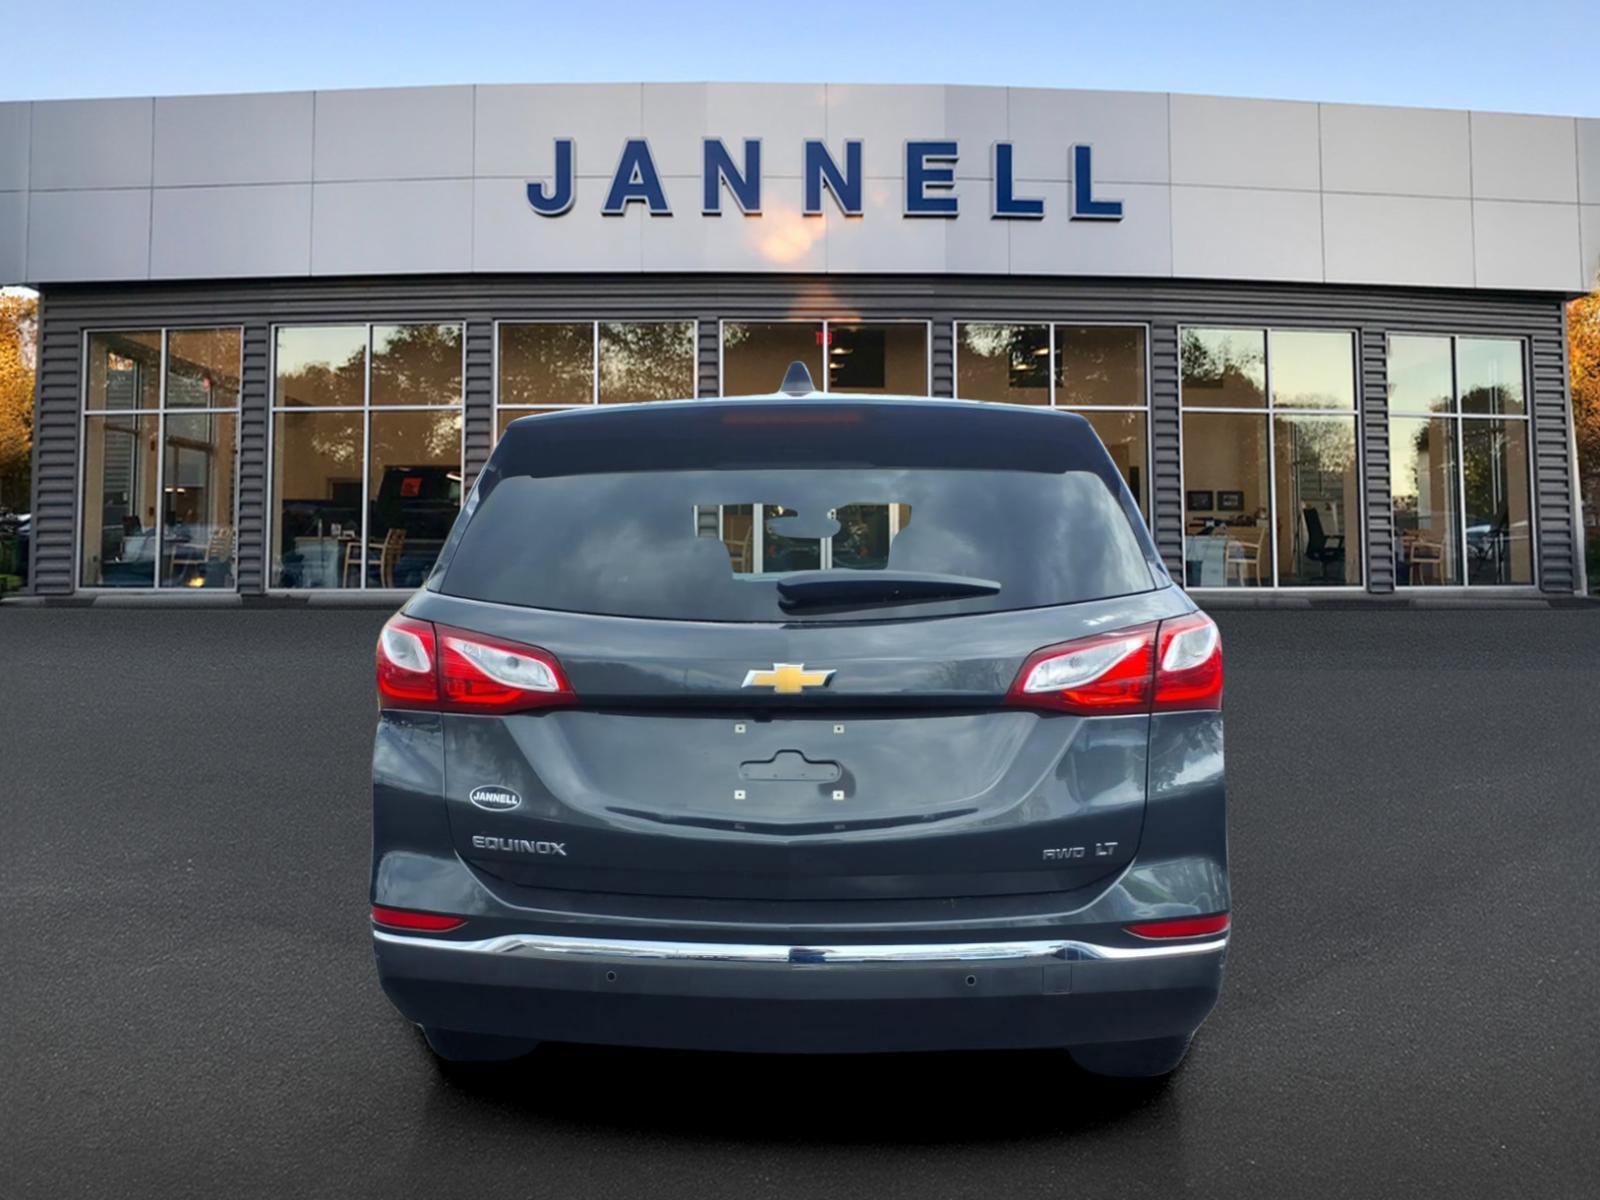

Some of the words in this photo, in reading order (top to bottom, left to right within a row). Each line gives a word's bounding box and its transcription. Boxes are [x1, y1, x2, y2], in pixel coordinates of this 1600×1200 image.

[526, 136, 1124, 220] JANNELL
[473, 791, 518, 805] JANNELL
[471, 835, 567, 856] EQUINOX
[1042, 846, 1085, 860] AWD
[1095, 841, 1119, 856] LT
